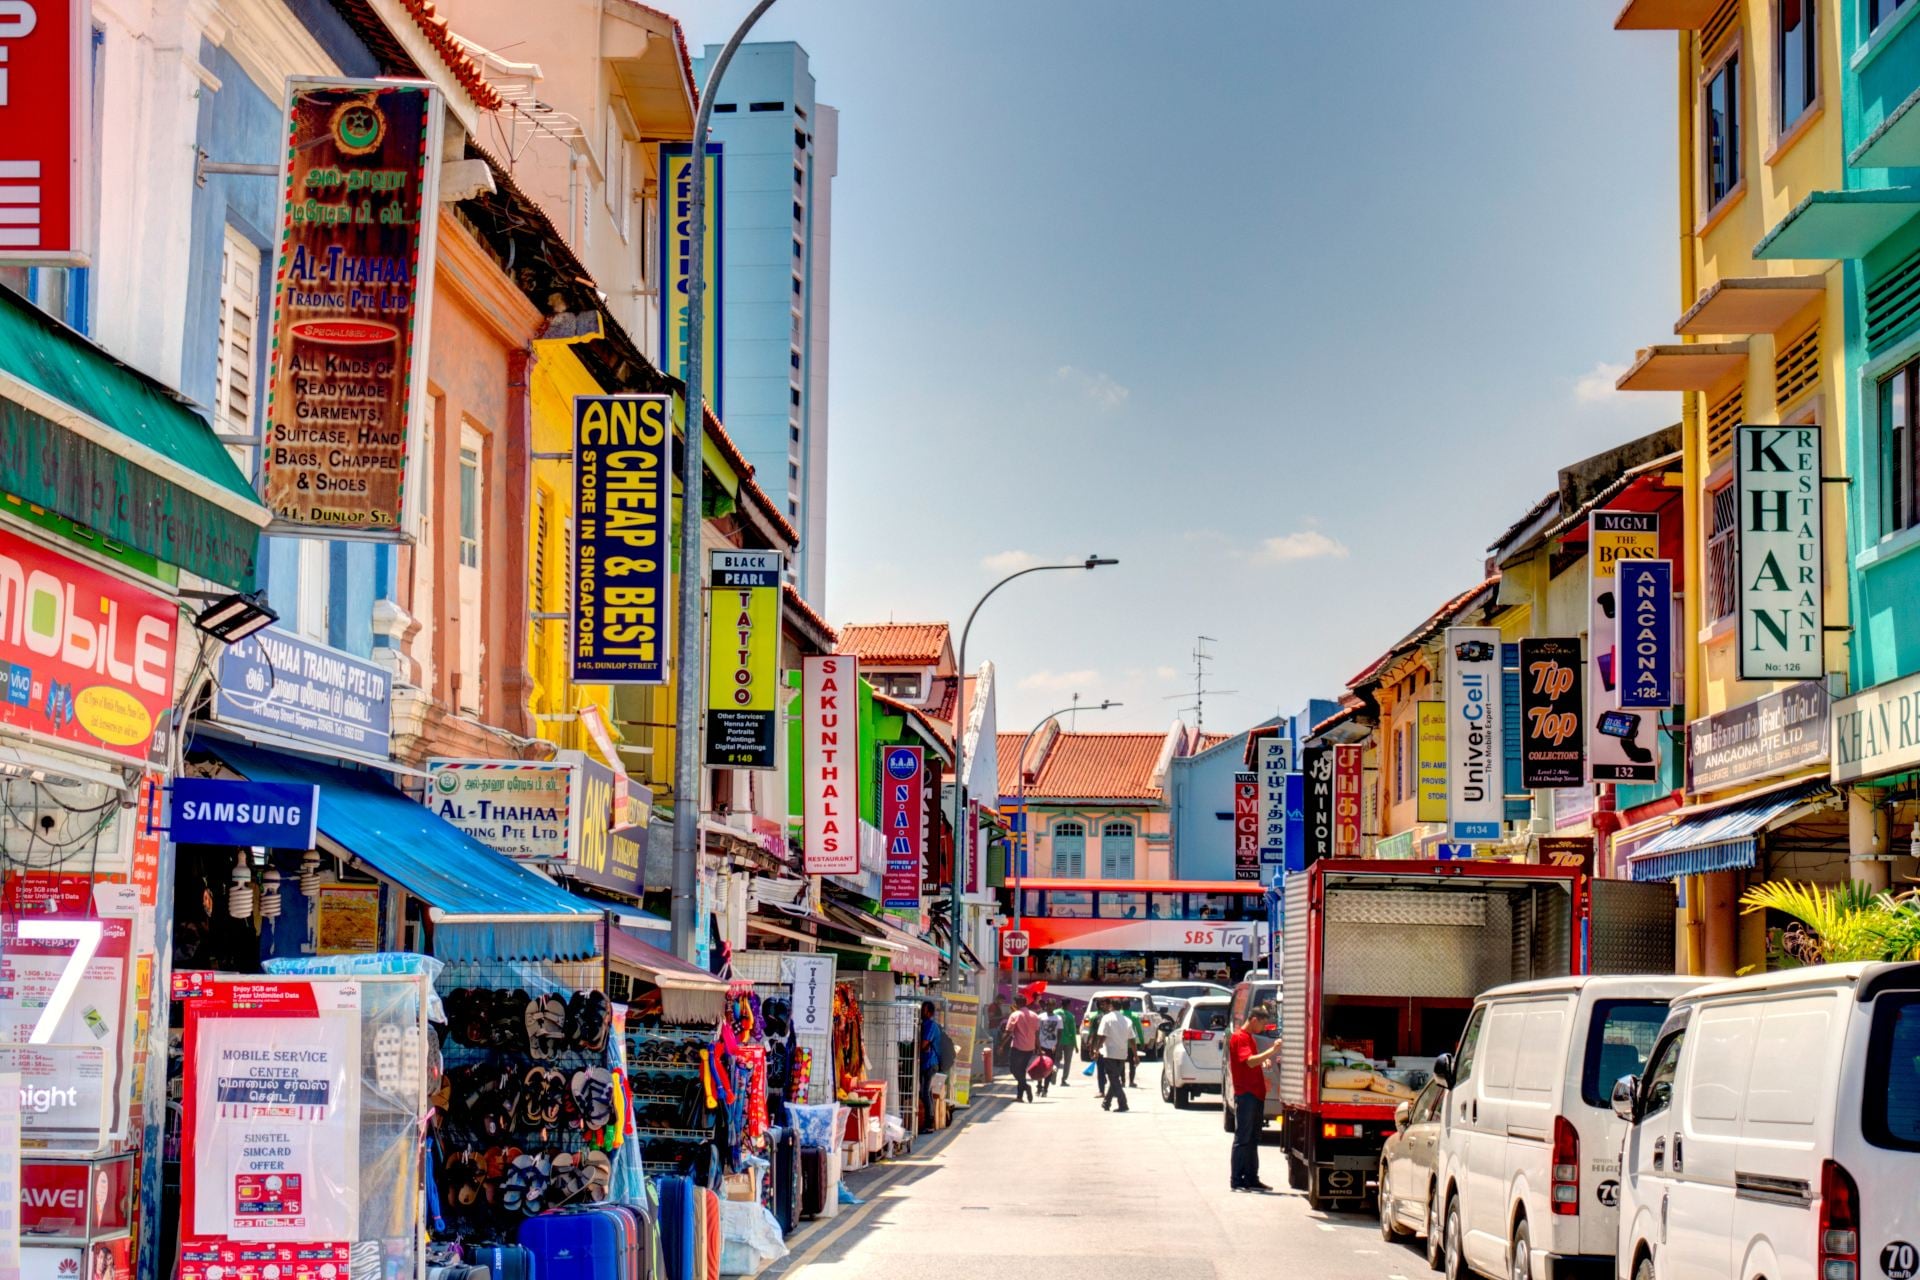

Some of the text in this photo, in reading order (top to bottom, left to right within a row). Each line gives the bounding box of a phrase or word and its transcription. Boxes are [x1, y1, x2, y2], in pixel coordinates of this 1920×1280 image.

[288, 245, 409, 283] AL-THAHAA
[287, 287, 408, 309] TRADING PTE LTD
[289, 355, 394, 374] ALL KINDS OF
[295, 379, 384, 397] READYMADE
[296, 403, 381, 423] GARMENTS,
[581, 401, 664, 446] ANS
[275, 425, 400, 446] SUITCASE, HAND
[275, 450, 397, 469] BAGS, CHAPPEL
[297, 474, 366, 491] & SHOES
[311, 508, 391, 523] DUNLOP ST.
[1604, 516, 1649, 530] MGM
[1615, 536, 1637, 544] THE
[1747, 430, 1794, 652] KHAN
[1796, 431, 1815, 652] RESTAURANT
[579, 450, 597, 658] STORE IN SINGAPORE
[602, 450, 658, 661] CHEAP & BEST
[725, 556, 765, 567] BLACK
[1599, 547, 1655, 563] BOSS
[724, 573, 765, 585] PEARL
[1636, 571, 1657, 684] ANACAONA
[734, 592, 751, 706] TATTOO
[256, 635, 301, 675] THAHAA
[303, 651, 347, 689] TRADING
[347, 666, 366, 697] PTE
[577, 662, 658, 670] 145, DUNLOP STREET
[1765, 662, 1800, 672] No: 126
[11, 671, 30, 691] vivo
[1529, 659, 1574, 700] Tip
[263, 705, 279, 723] Dunlop
[1528, 705, 1577, 746] Top
[1836, 700, 1891, 766] KHAN
[152, 731, 166, 753] 139
[715, 743, 735, 751] Digital
[1463, 674, 1484, 802] UniverCell
[1705, 741, 1758, 769] ANACAONA
[1760, 734, 1780, 753] PTE
[1783, 727, 1803, 746] LTD
[820, 660, 838, 852] SAKUNTHALAS
[1528, 751, 1579, 760] COLLECTIONS
[1310, 757, 1333, 781] My
[1614, 767, 1634, 778] 132
[182, 800, 301, 826] SAMSUNG
[439, 799, 558, 821] AL-THAHAA
[581, 775, 611, 874] ANS
[1237, 800, 1259, 850] MGR
[1314, 783, 1329, 859] MINOR
[1466, 826, 1487, 834] #134
[502, 826, 558, 839] PTE LTD
[520, 844, 533, 853] ST.
[1004, 938, 1027, 949] STOP
[1184, 930, 1214, 944] SBS
[17, 920, 103, 1045] 7
[806, 967, 816, 1024] TATTOO
[222, 1050, 328, 1063] MOBILE SERVICE
[249, 1067, 299, 1078] CENTER
[244, 1133, 290, 1143] SINGTEL
[243, 1148, 291, 1157] SIMCARD
[250, 1161, 284, 1170] OFFER
[21, 1188, 84, 1208] AWEI
[1886, 1245, 1915, 1270] 70
[1889, 1269, 1912, 1280] km/h
